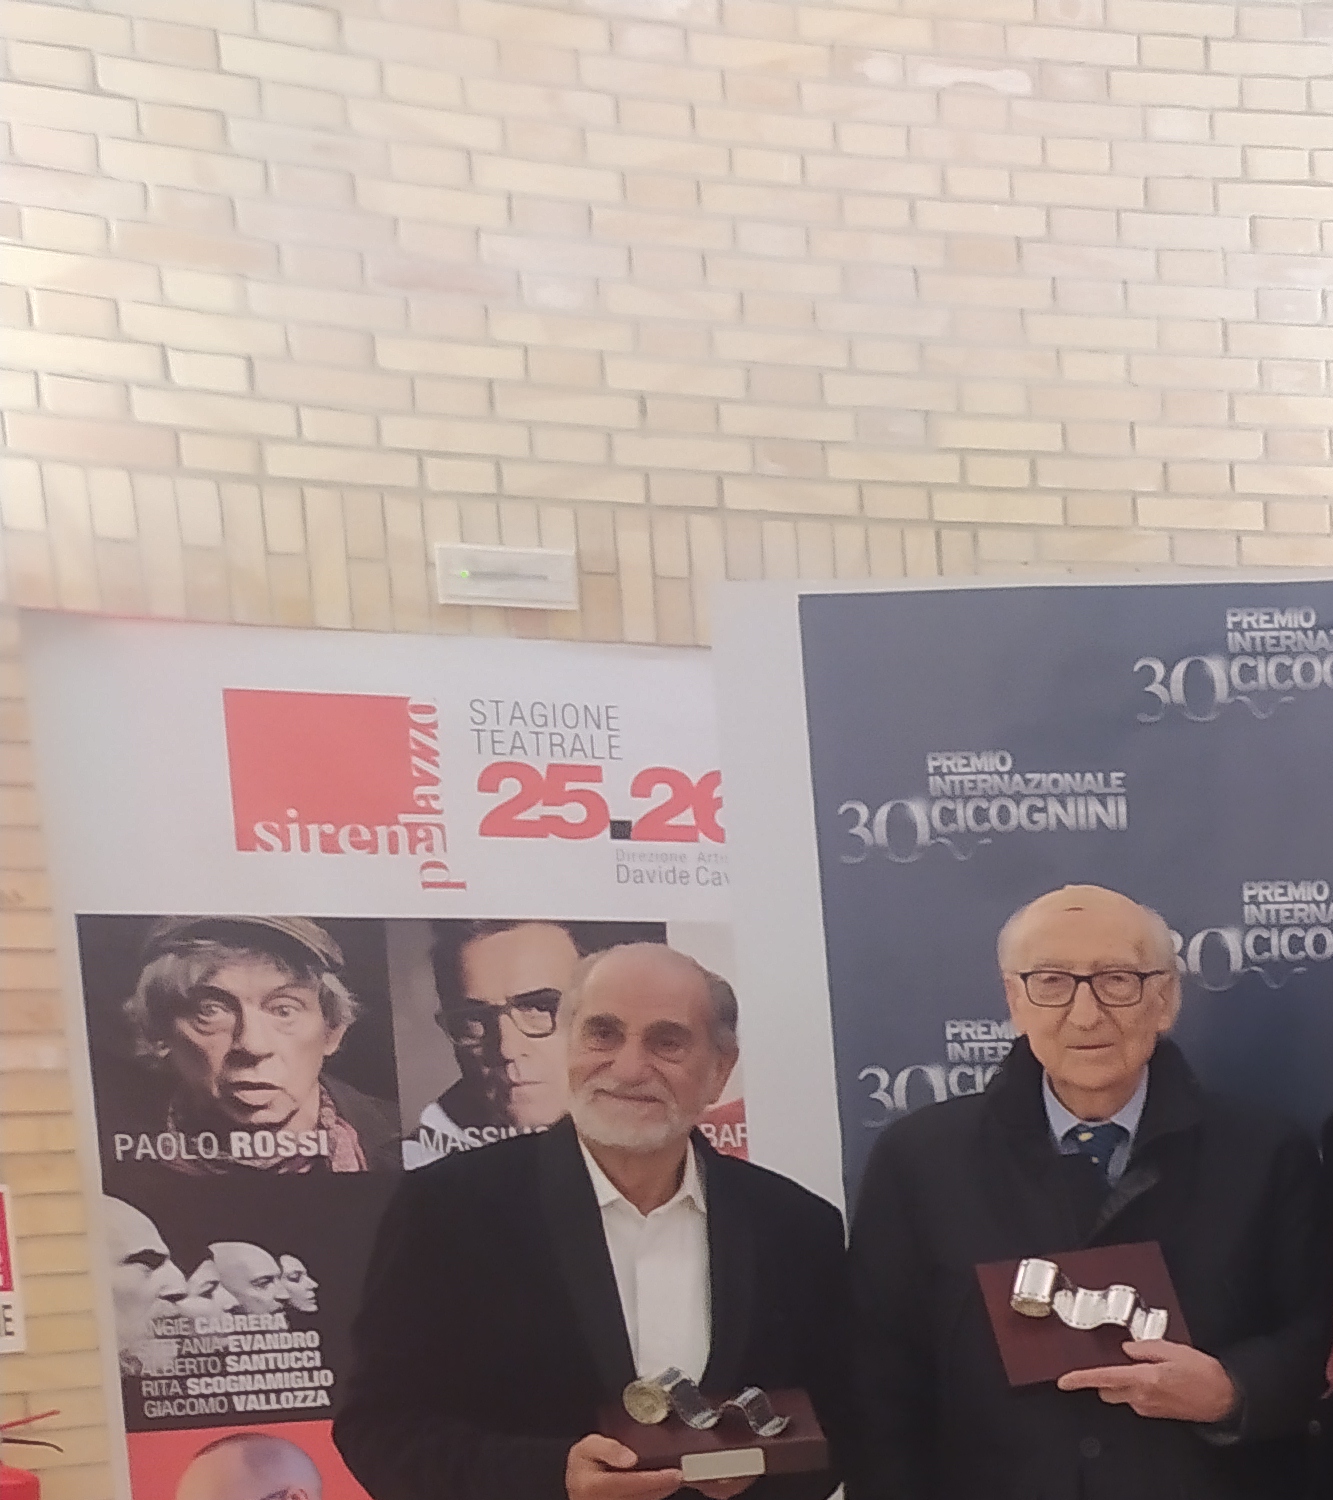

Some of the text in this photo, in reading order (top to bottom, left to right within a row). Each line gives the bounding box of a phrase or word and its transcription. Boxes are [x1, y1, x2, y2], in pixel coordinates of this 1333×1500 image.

[1226, 607, 1317, 629] PREMIO
[469, 698, 621, 732] STAGIONE
[471, 728, 623, 760] TEATRALE
[927, 750, 1013, 773] PREMIO
[928, 772, 1128, 795] INTERNAZIONALE
[931, 797, 1128, 833] CICOGNINI
[253, 808, 442, 855] sirena
[616, 864, 691, 886] Davide
[1243, 880, 1330, 903] PREMIO
[114, 1129, 330, 1161] PAOLO ROSSI
[149, 1317, 195, 1336] NGIE
[226, 1330, 320, 1352] EVANDRO
[225, 1350, 322, 1373] SANTUCCI
[141, 1368, 334, 1397] RITA SCOGNAMIGLIO
[144, 1389, 331, 1419] GIACOMO VALLOZZA
